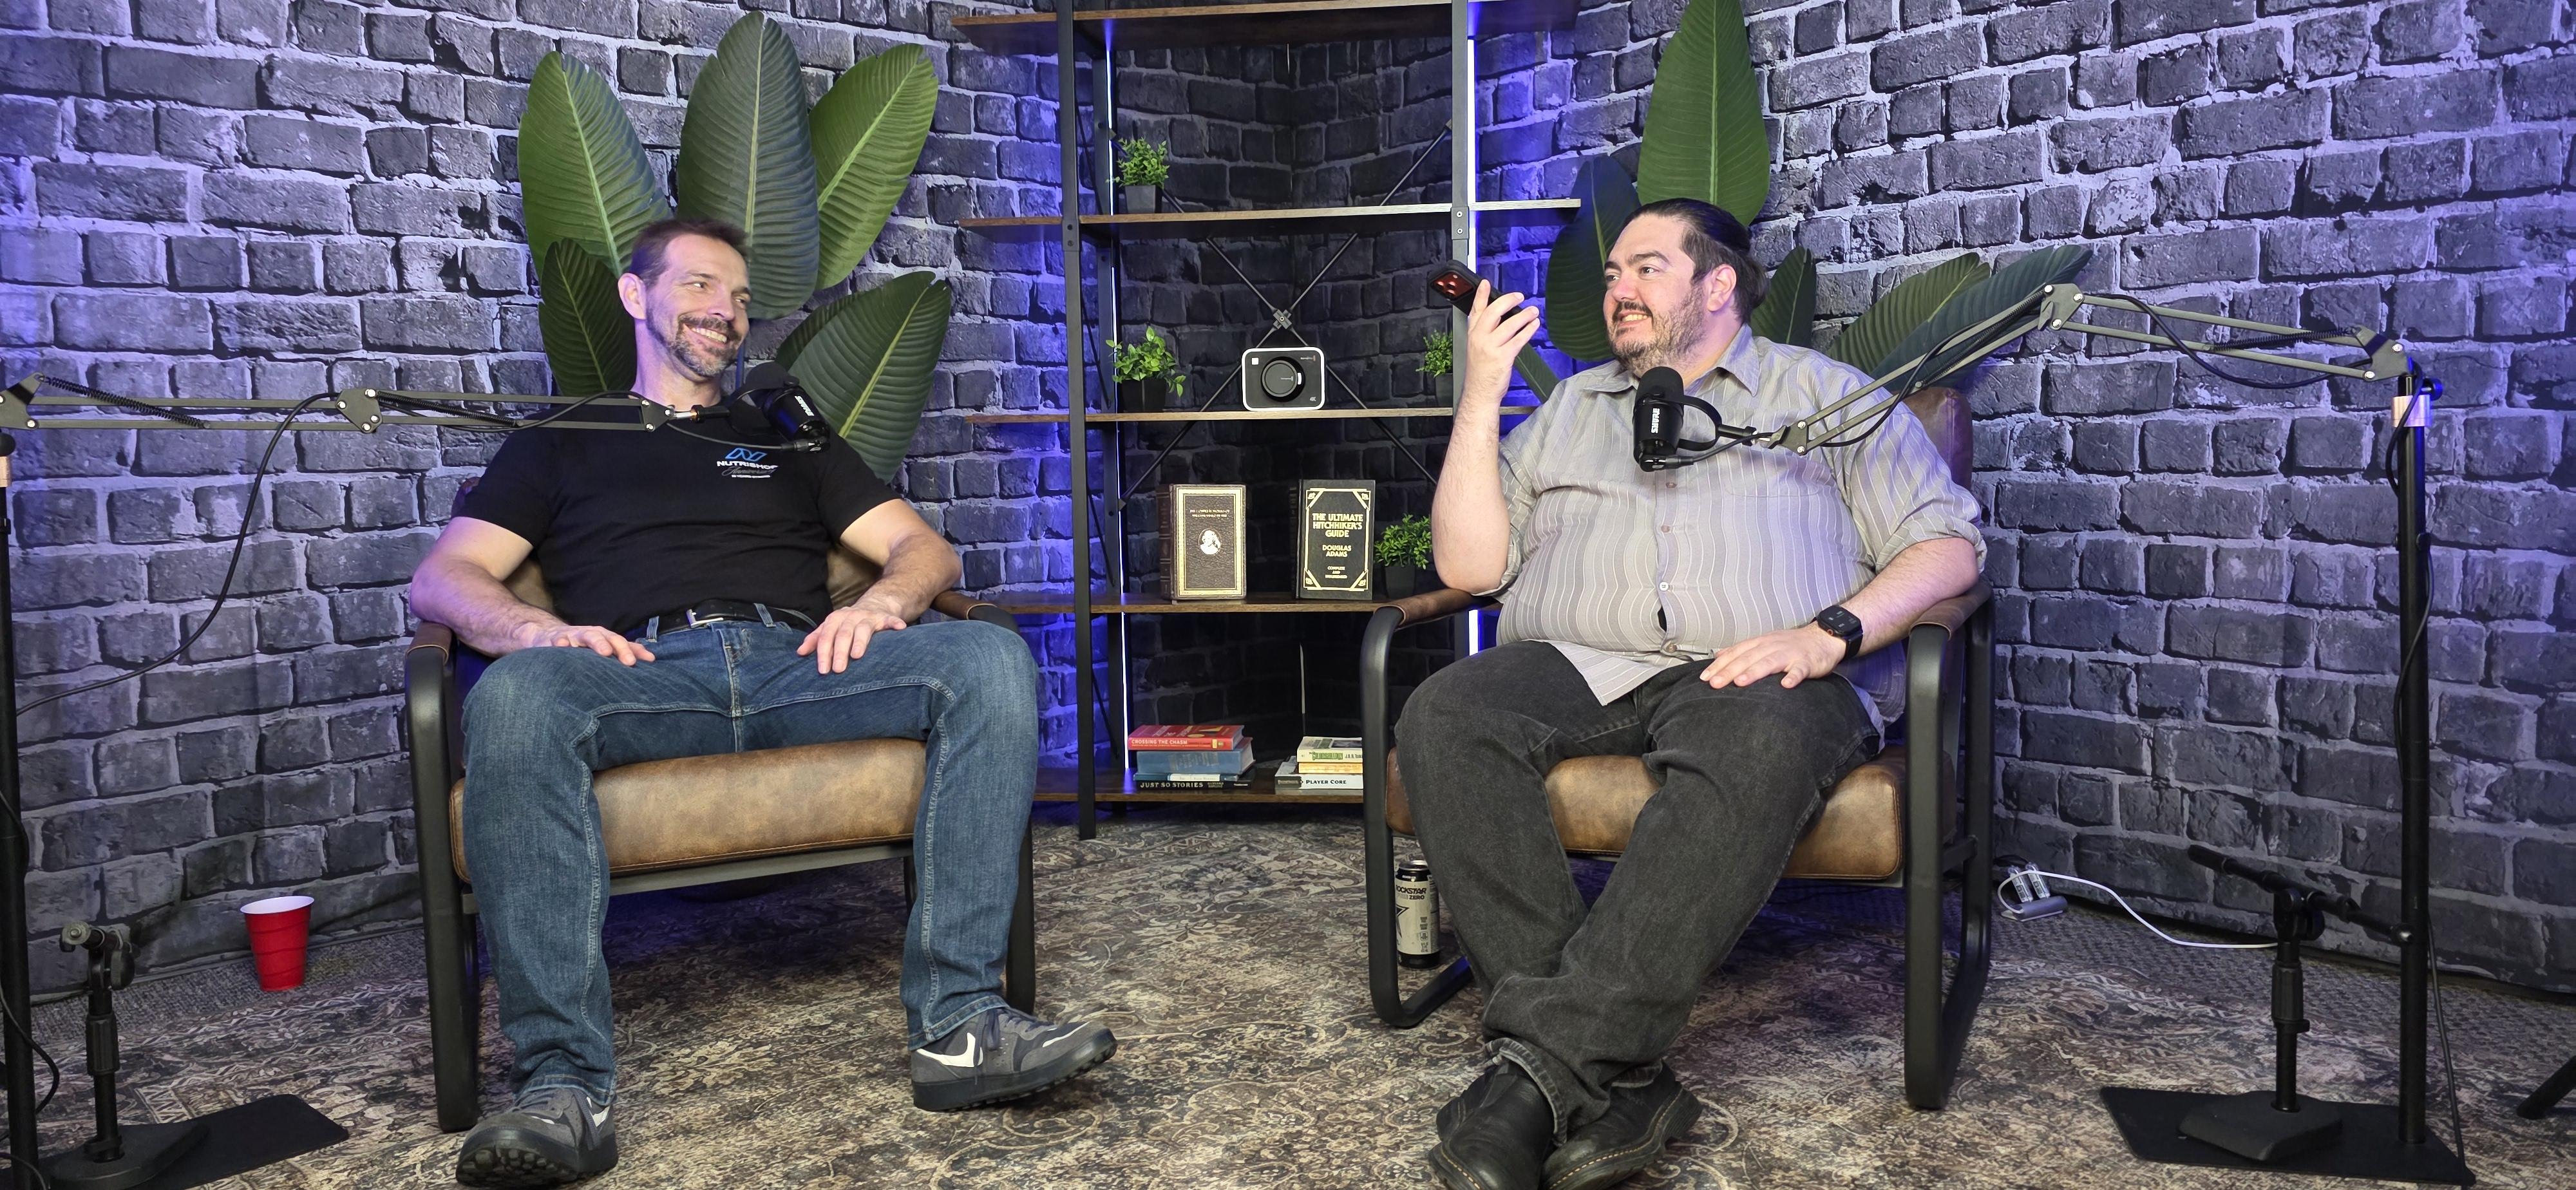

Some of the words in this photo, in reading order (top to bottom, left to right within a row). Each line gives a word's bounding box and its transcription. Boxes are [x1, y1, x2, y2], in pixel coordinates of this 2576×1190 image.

[1651, 408, 1660, 433] SHURE
[716, 460, 778, 469] NUTRISHOP
[1328, 513, 1363, 522] ULTIMATE
[1312, 521, 1363, 530] HITCHHIKER'S
[1396, 885, 1427, 894] OCKSTAR
